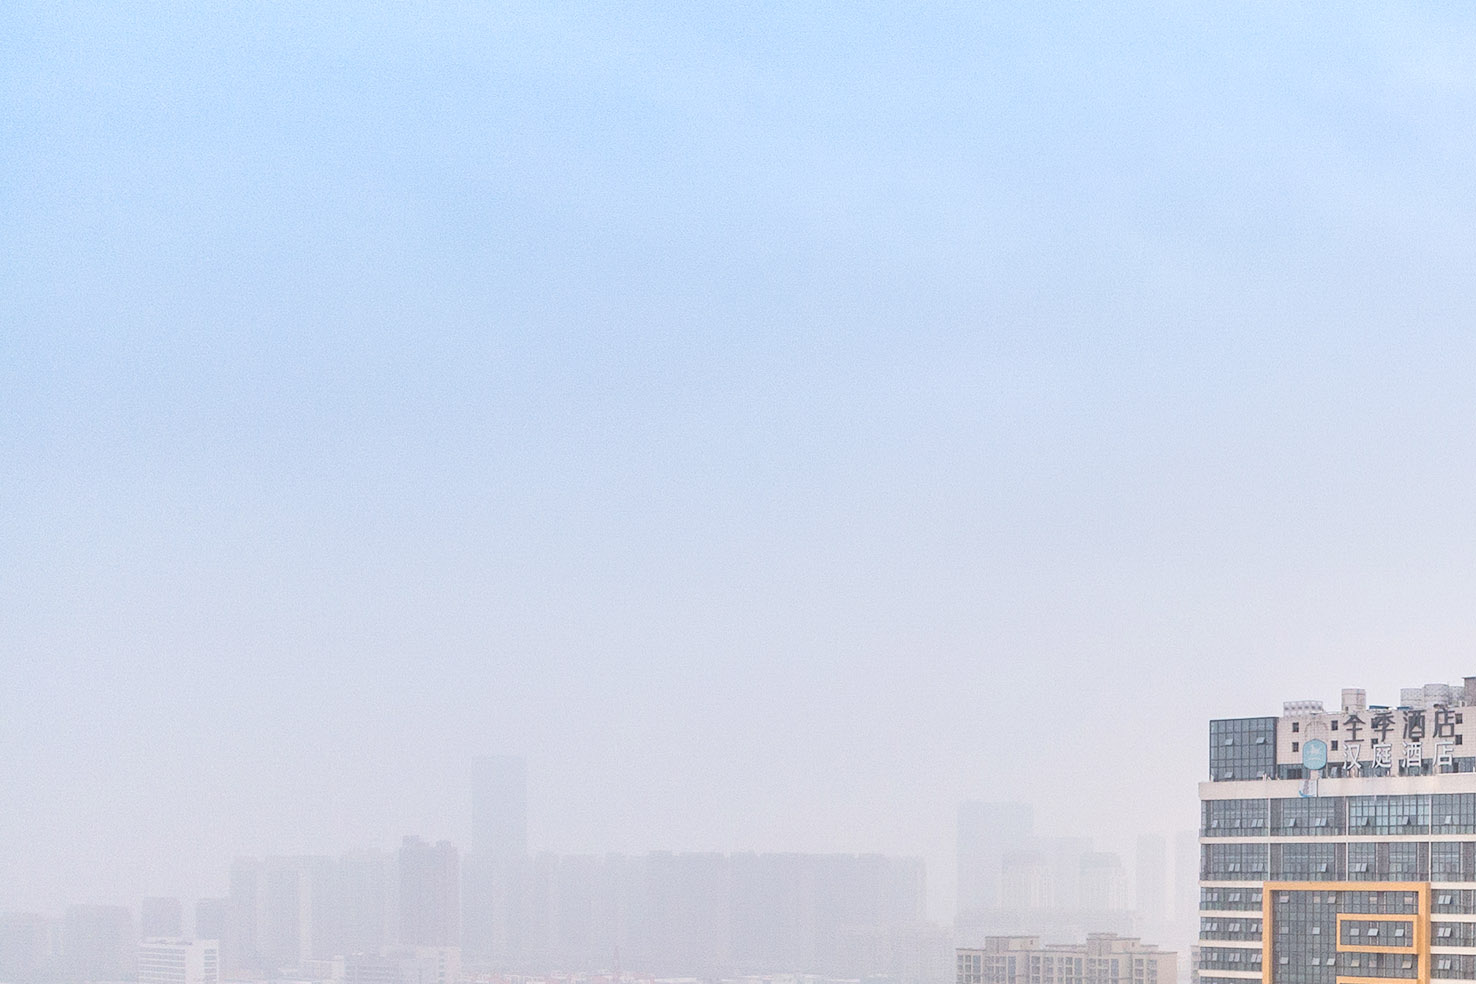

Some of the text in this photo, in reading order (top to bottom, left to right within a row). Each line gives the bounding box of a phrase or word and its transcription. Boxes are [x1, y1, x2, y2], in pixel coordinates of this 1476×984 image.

[1344, 706, 1455, 742] 全季酒店
[1342, 741, 1454, 769] 汉庭酒店
